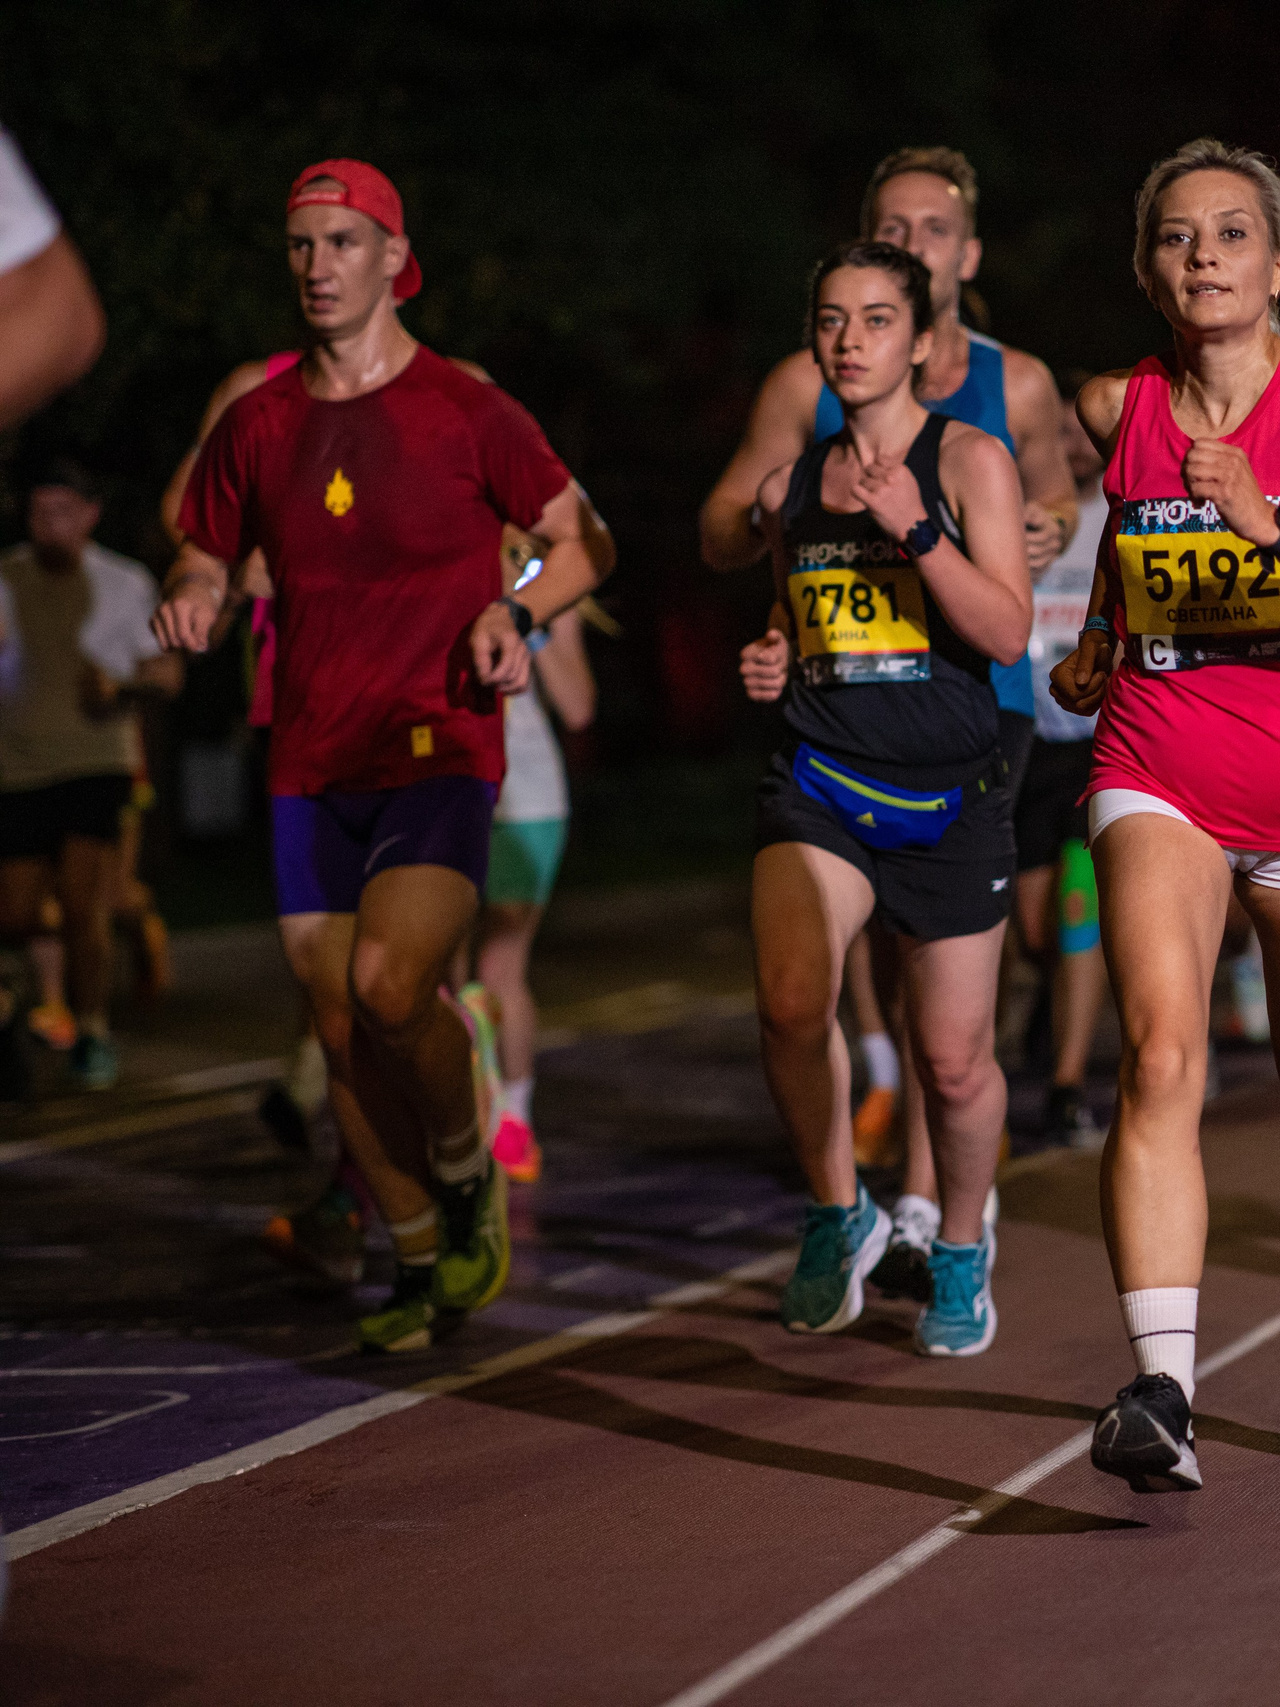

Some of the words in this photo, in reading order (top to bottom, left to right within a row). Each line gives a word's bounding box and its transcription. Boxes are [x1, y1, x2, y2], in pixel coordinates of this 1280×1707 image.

[1142, 548, 1280, 603] 5192
[802, 582, 899, 628] 2781
[1166, 605, 1258, 624] СВЕТЛАНА
[829, 629, 870, 642] АННА
